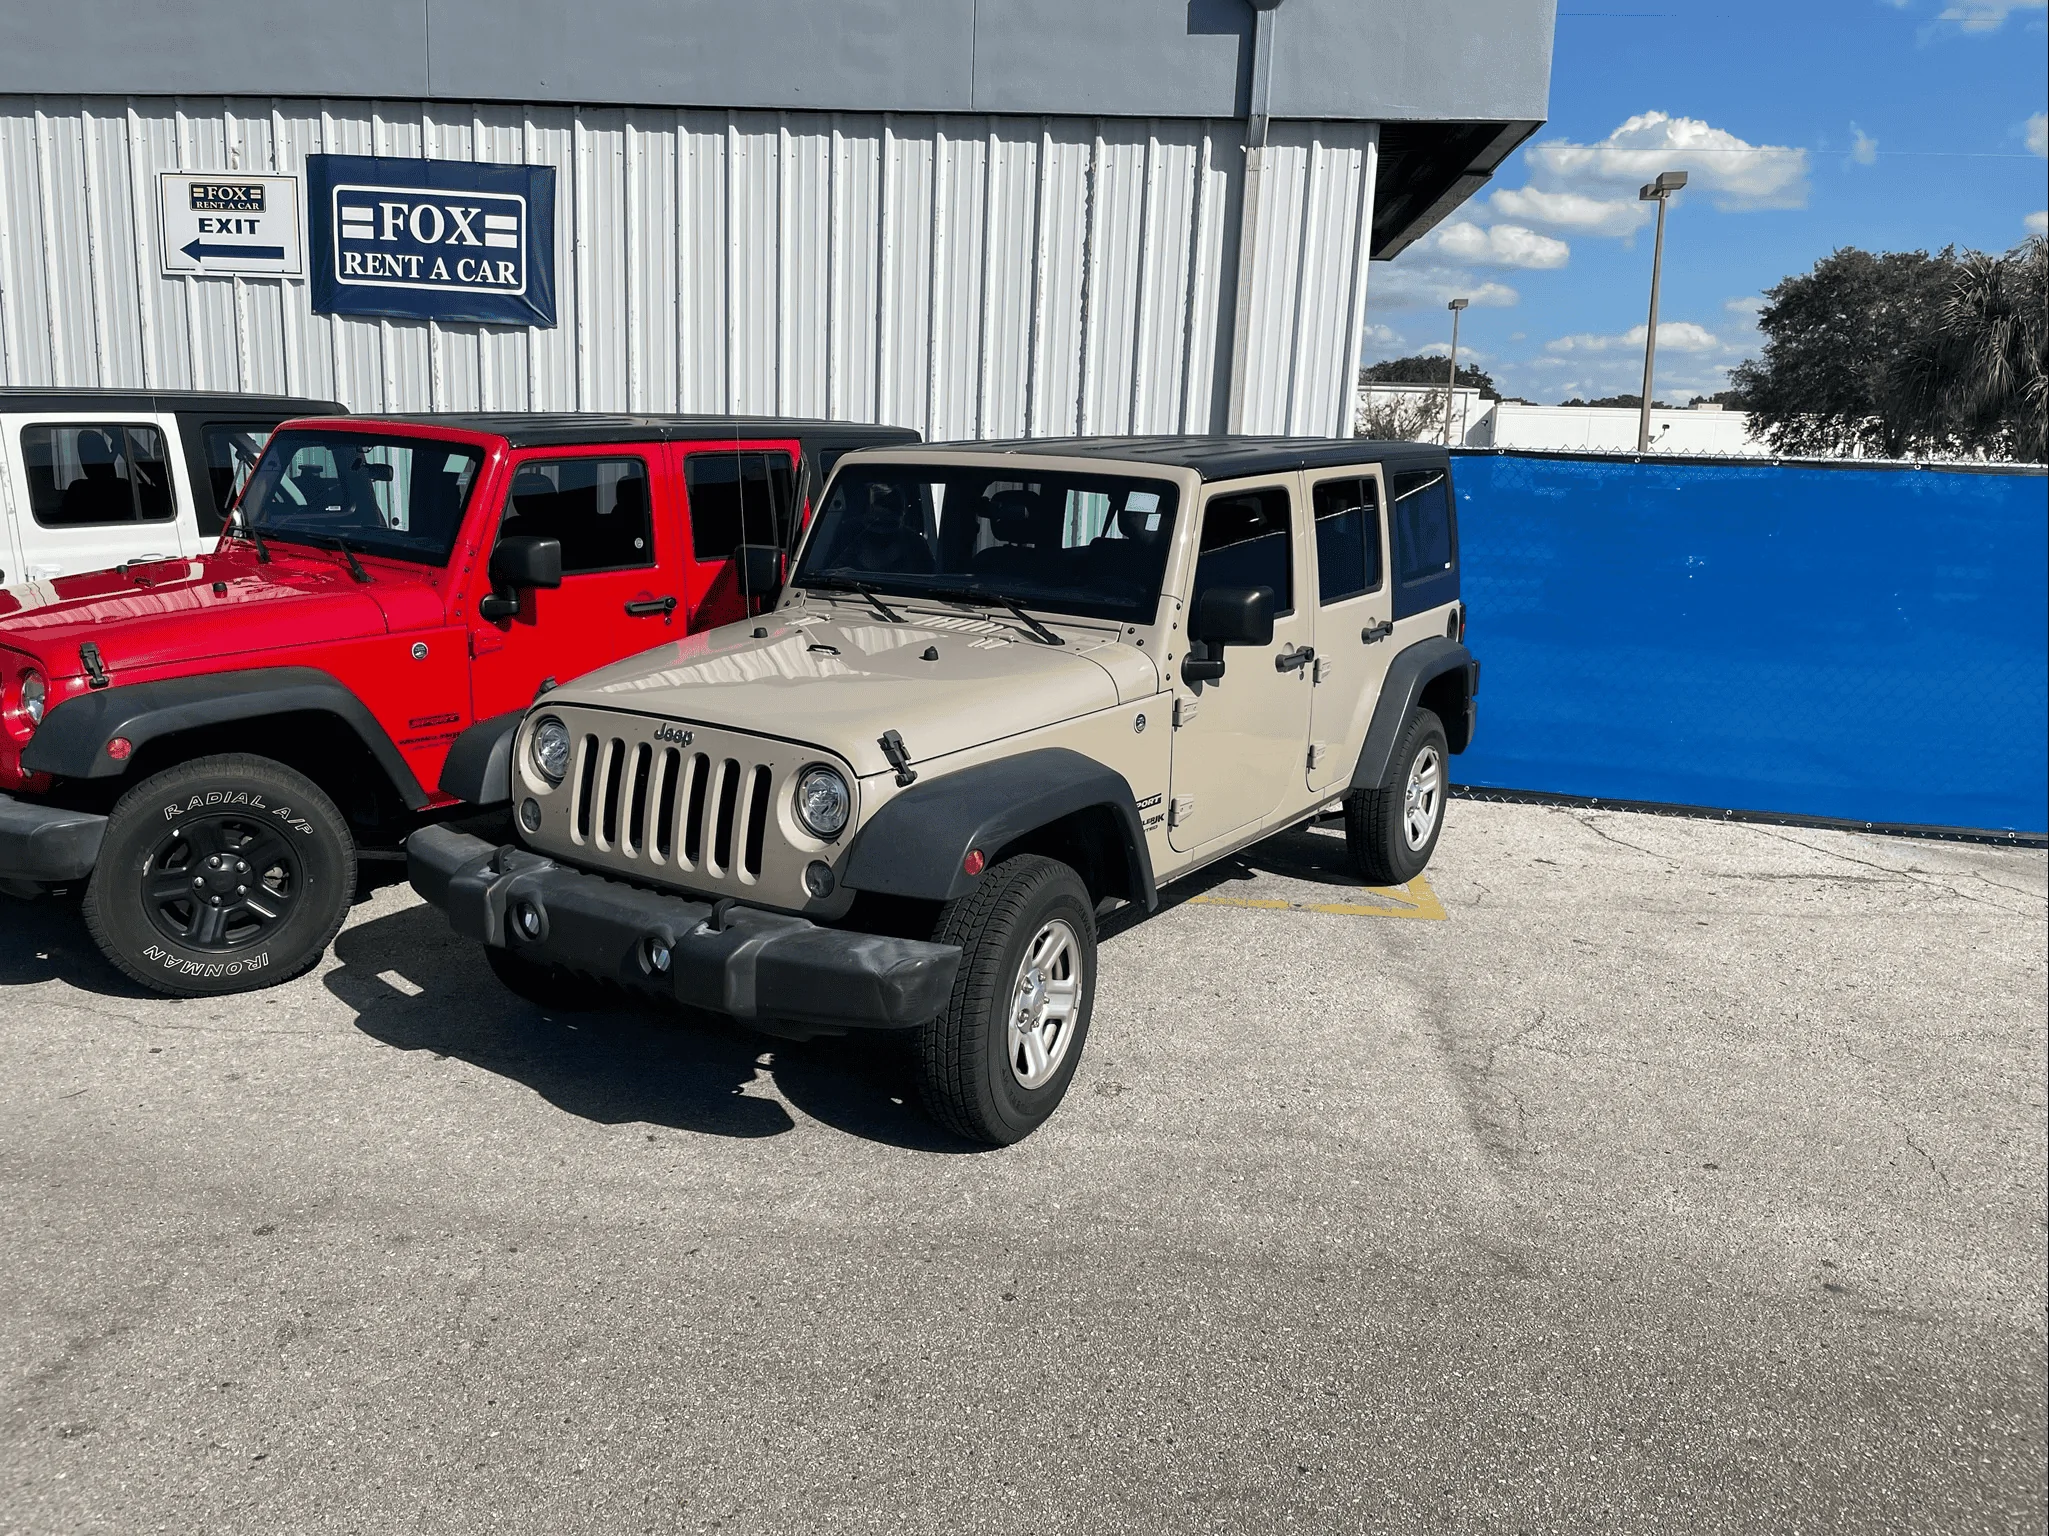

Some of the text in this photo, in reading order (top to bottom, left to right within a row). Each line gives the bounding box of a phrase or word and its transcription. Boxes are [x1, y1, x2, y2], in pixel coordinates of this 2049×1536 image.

[196, 201, 259, 210] RENT A CAR
[206, 186, 248, 200] FOX
[198, 217, 260, 235] EXIT
[379, 202, 483, 246] FOX
[343, 251, 519, 285] RENT A CAR
[654, 722, 695, 748] Jeep
[164, 791, 314, 835] RADIAL A/P
[143, 945, 269, 977] IRONMAN
